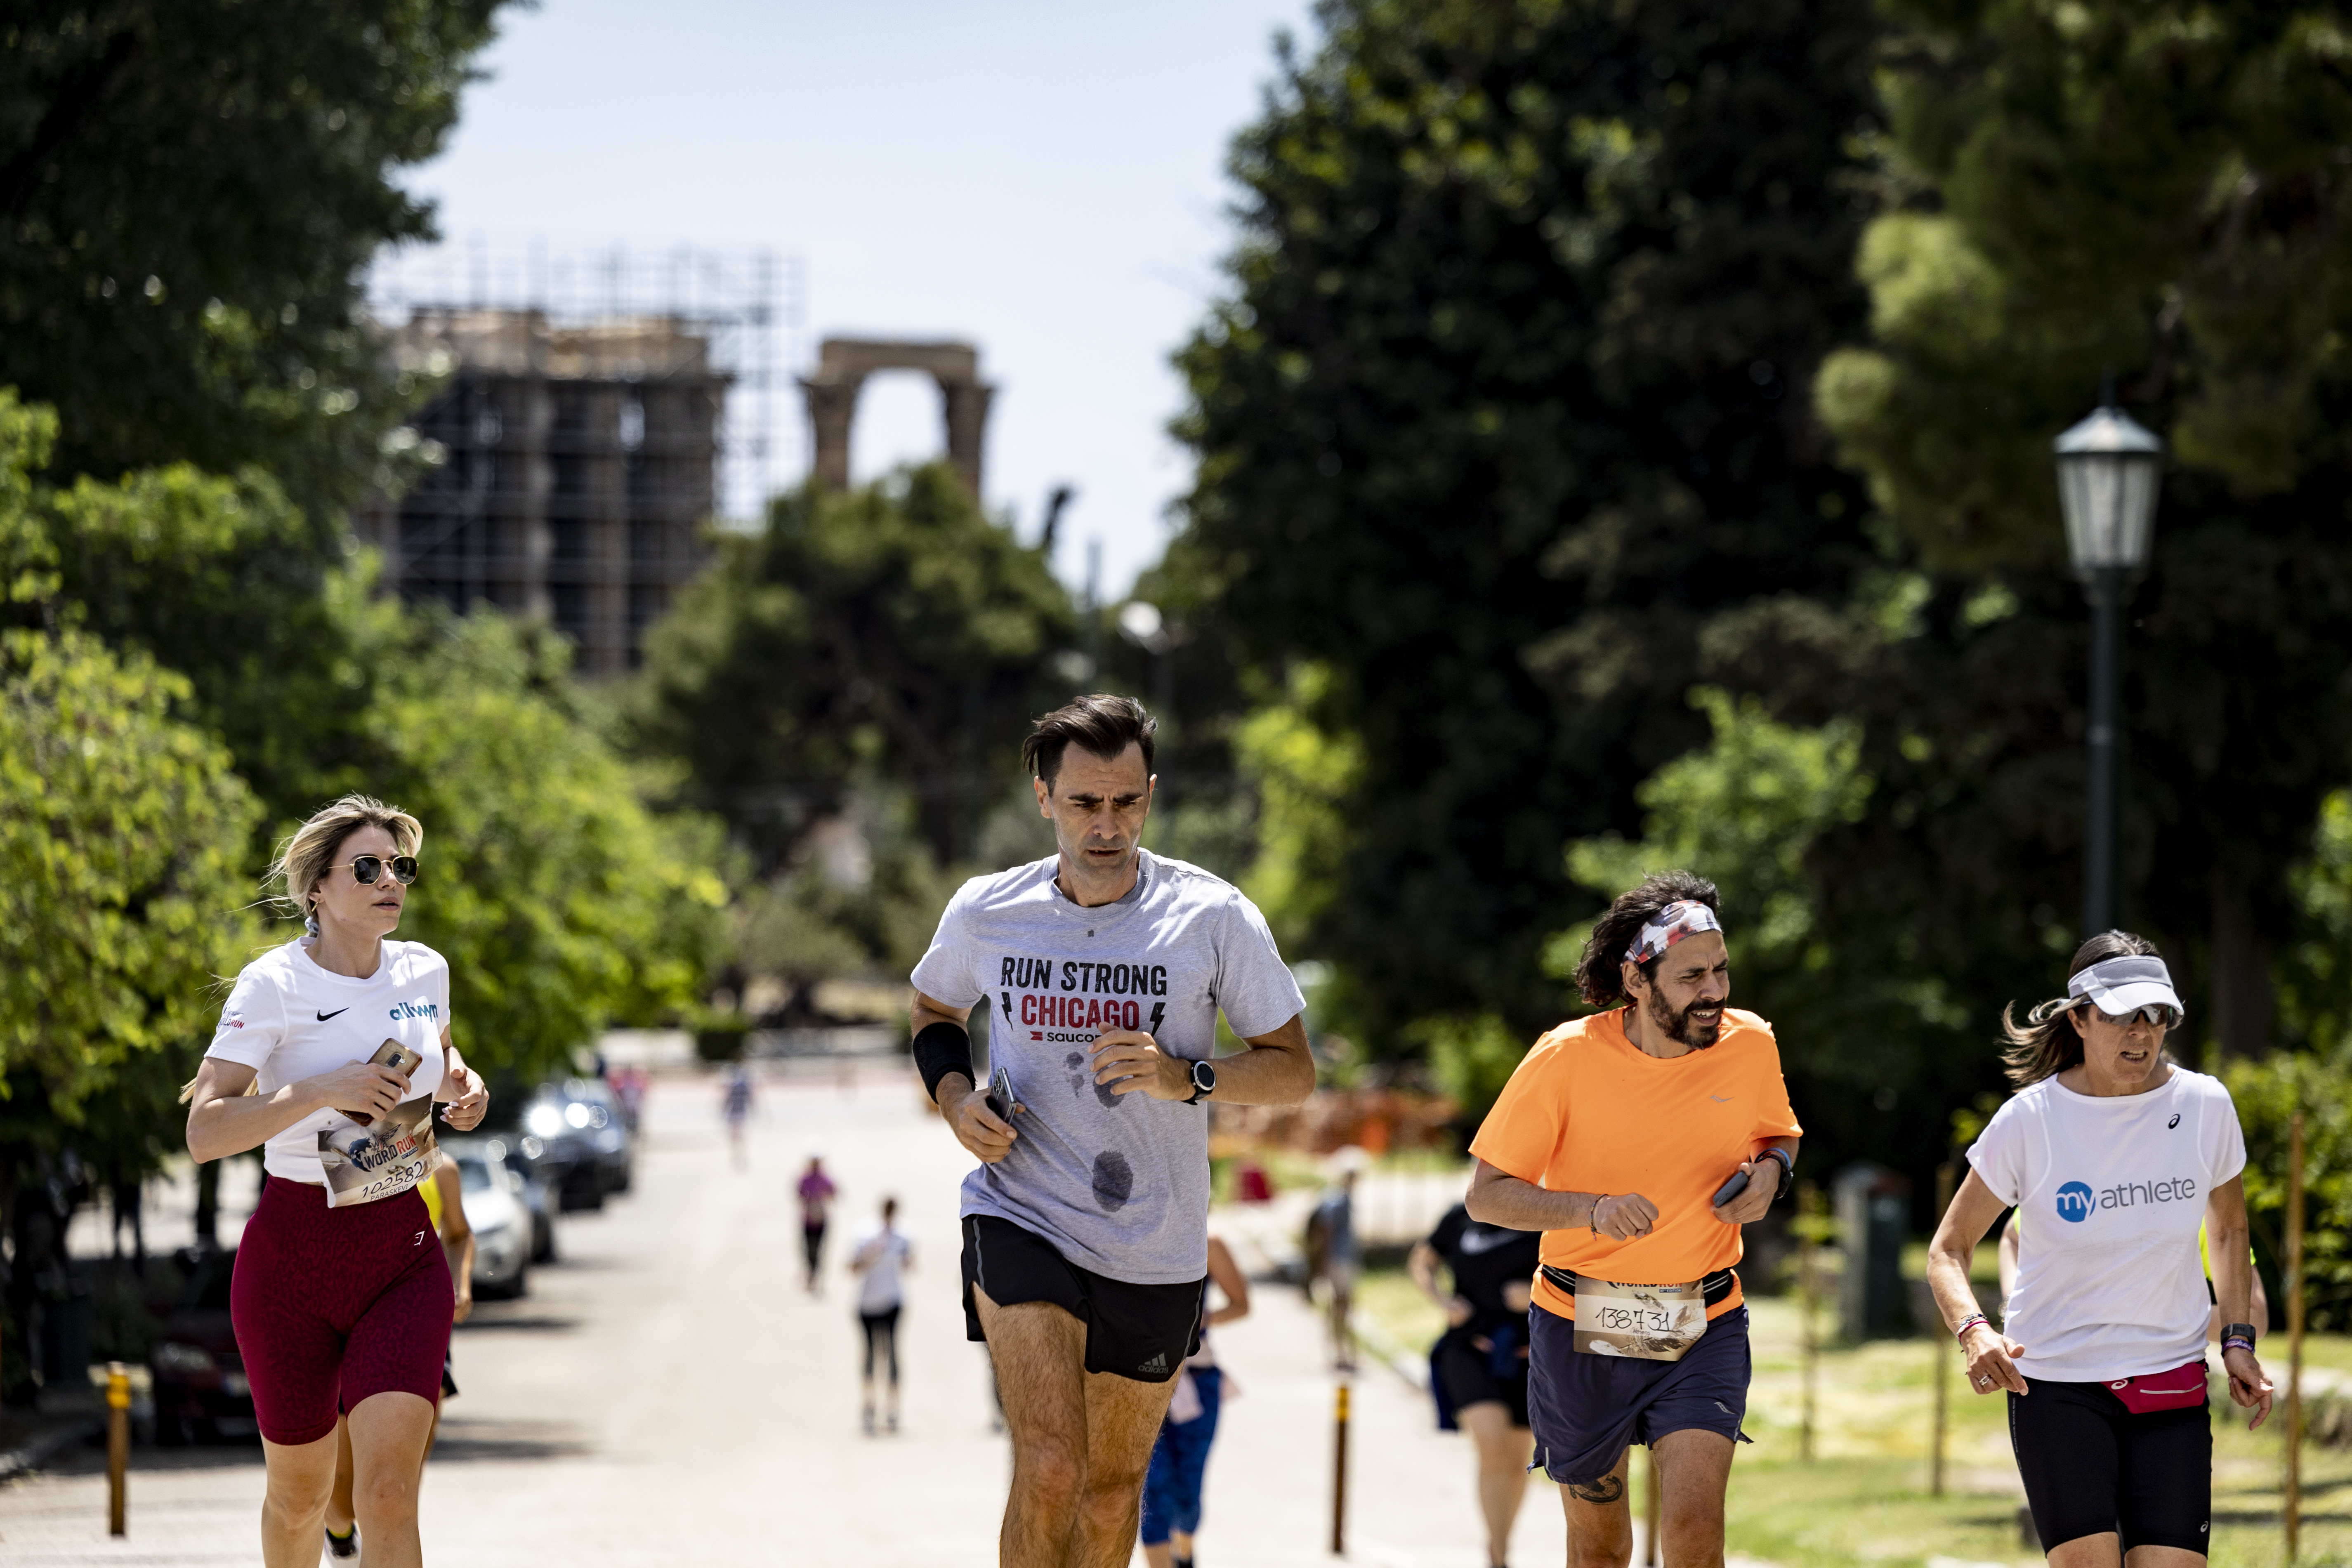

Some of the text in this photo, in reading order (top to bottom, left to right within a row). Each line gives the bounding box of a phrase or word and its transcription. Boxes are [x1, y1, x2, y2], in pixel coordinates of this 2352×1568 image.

[1000, 957, 1167, 996] RUN STRONG
[230, 1019, 245, 1029] RUN
[389, 1002, 438, 1023] allwyn
[1021, 995, 1139, 1031] CHICAGO
[1047, 1032, 1102, 1042] sauco
[364, 1134, 416, 1169] WORLD RUN
[362, 1161, 424, 1198] 102582
[370, 1184, 409, 1202] PARASKEVI
[1595, 1307, 1672, 1332] 138731
[1138, 1365, 1169, 1374] adidas
